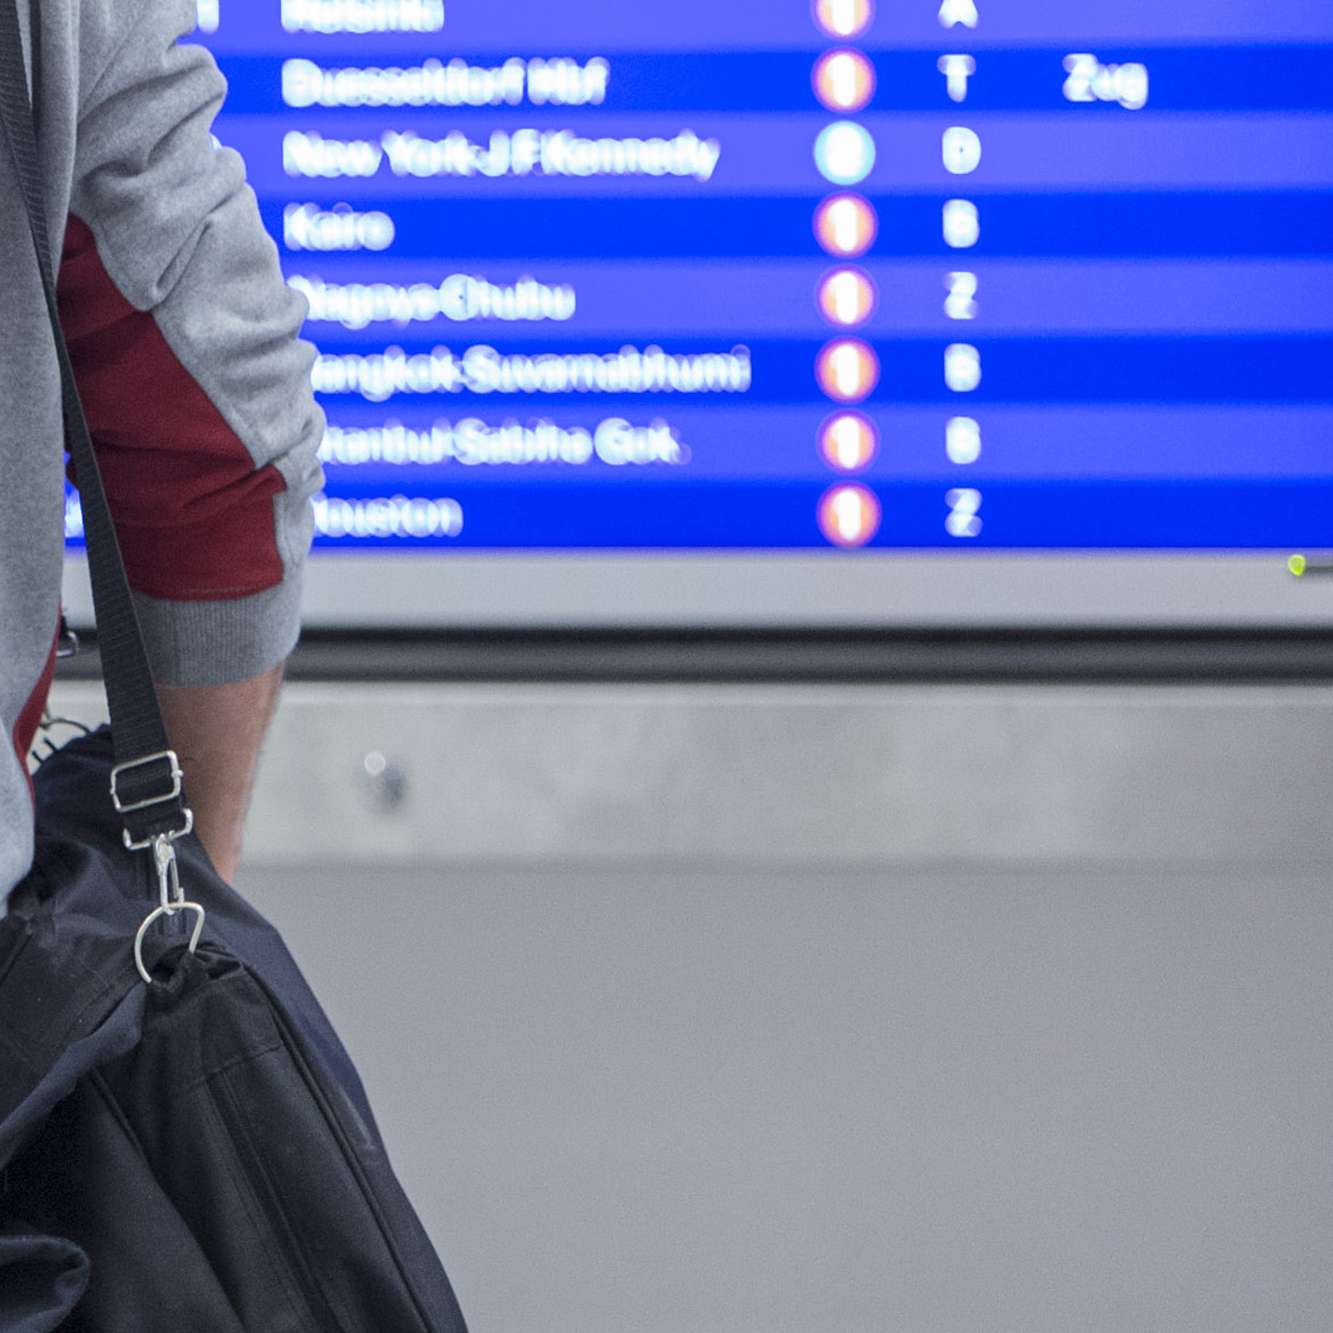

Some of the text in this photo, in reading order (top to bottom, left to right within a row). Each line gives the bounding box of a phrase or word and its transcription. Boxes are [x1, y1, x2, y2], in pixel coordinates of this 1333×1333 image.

[282, 58, 527, 106] Duesseldorf
[939, 55, 974, 101] T
[1064, 54, 1147, 109] Zug
[284, 132, 383, 176] New
[943, 128, 980, 173] D
[283, 208, 394, 251] Kairo
[944, 200, 978, 247] B
[946, 273, 976, 318] Z
[316, 344, 750, 403] angkok-Suvarnabhumi
[946, 344, 980, 390] B
[947, 418, 980, 463] B
[310, 489, 462, 544] ouston
[947, 489, 980, 535] Z
